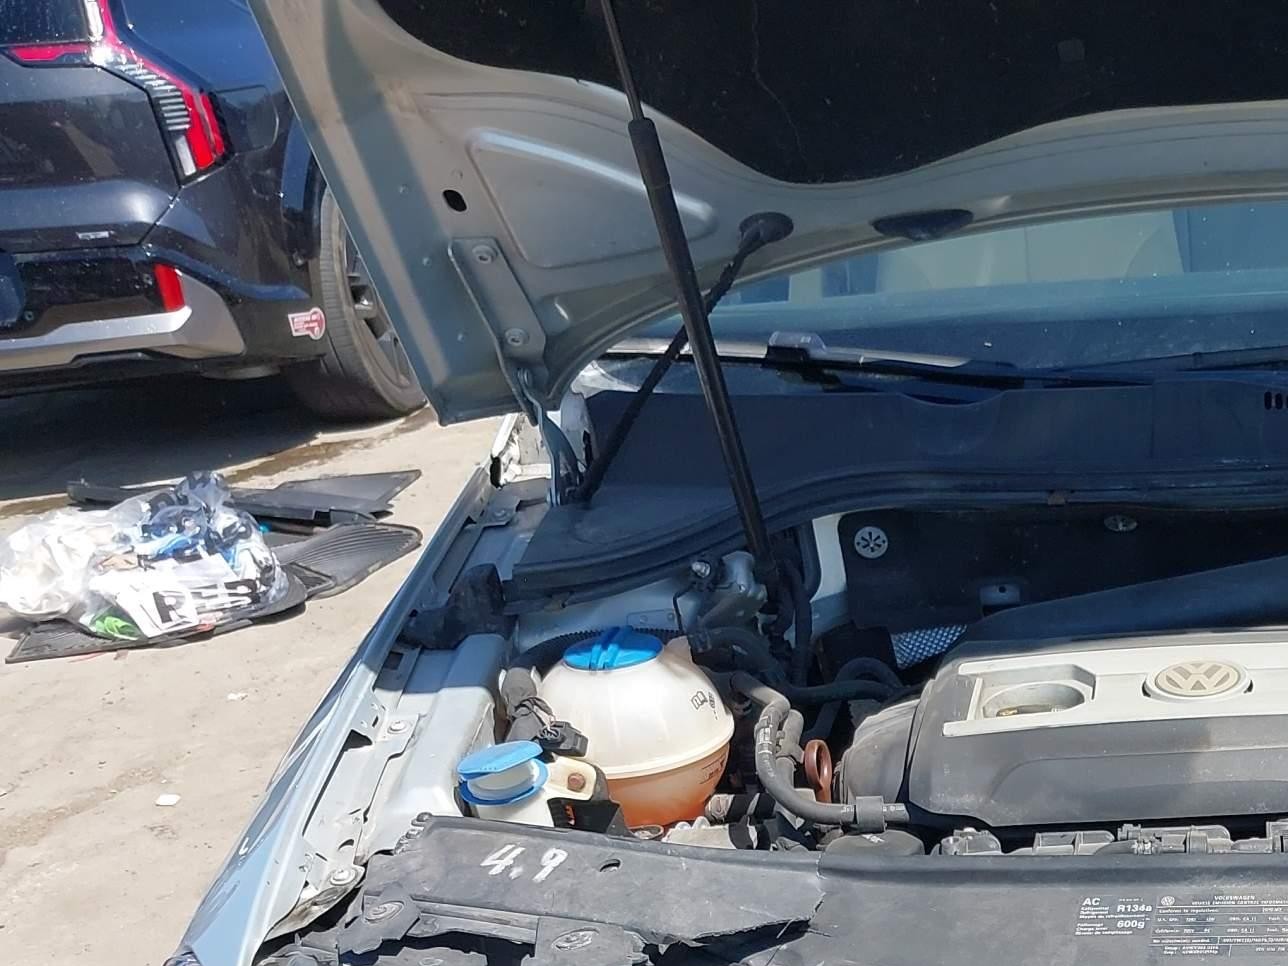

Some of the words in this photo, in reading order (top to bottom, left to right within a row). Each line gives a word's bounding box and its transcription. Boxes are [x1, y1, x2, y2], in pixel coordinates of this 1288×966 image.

[1081, 896, 1101, 906] AC
[1116, 904, 1153, 913] R134a
[1116, 919, 1146, 929] 600g
